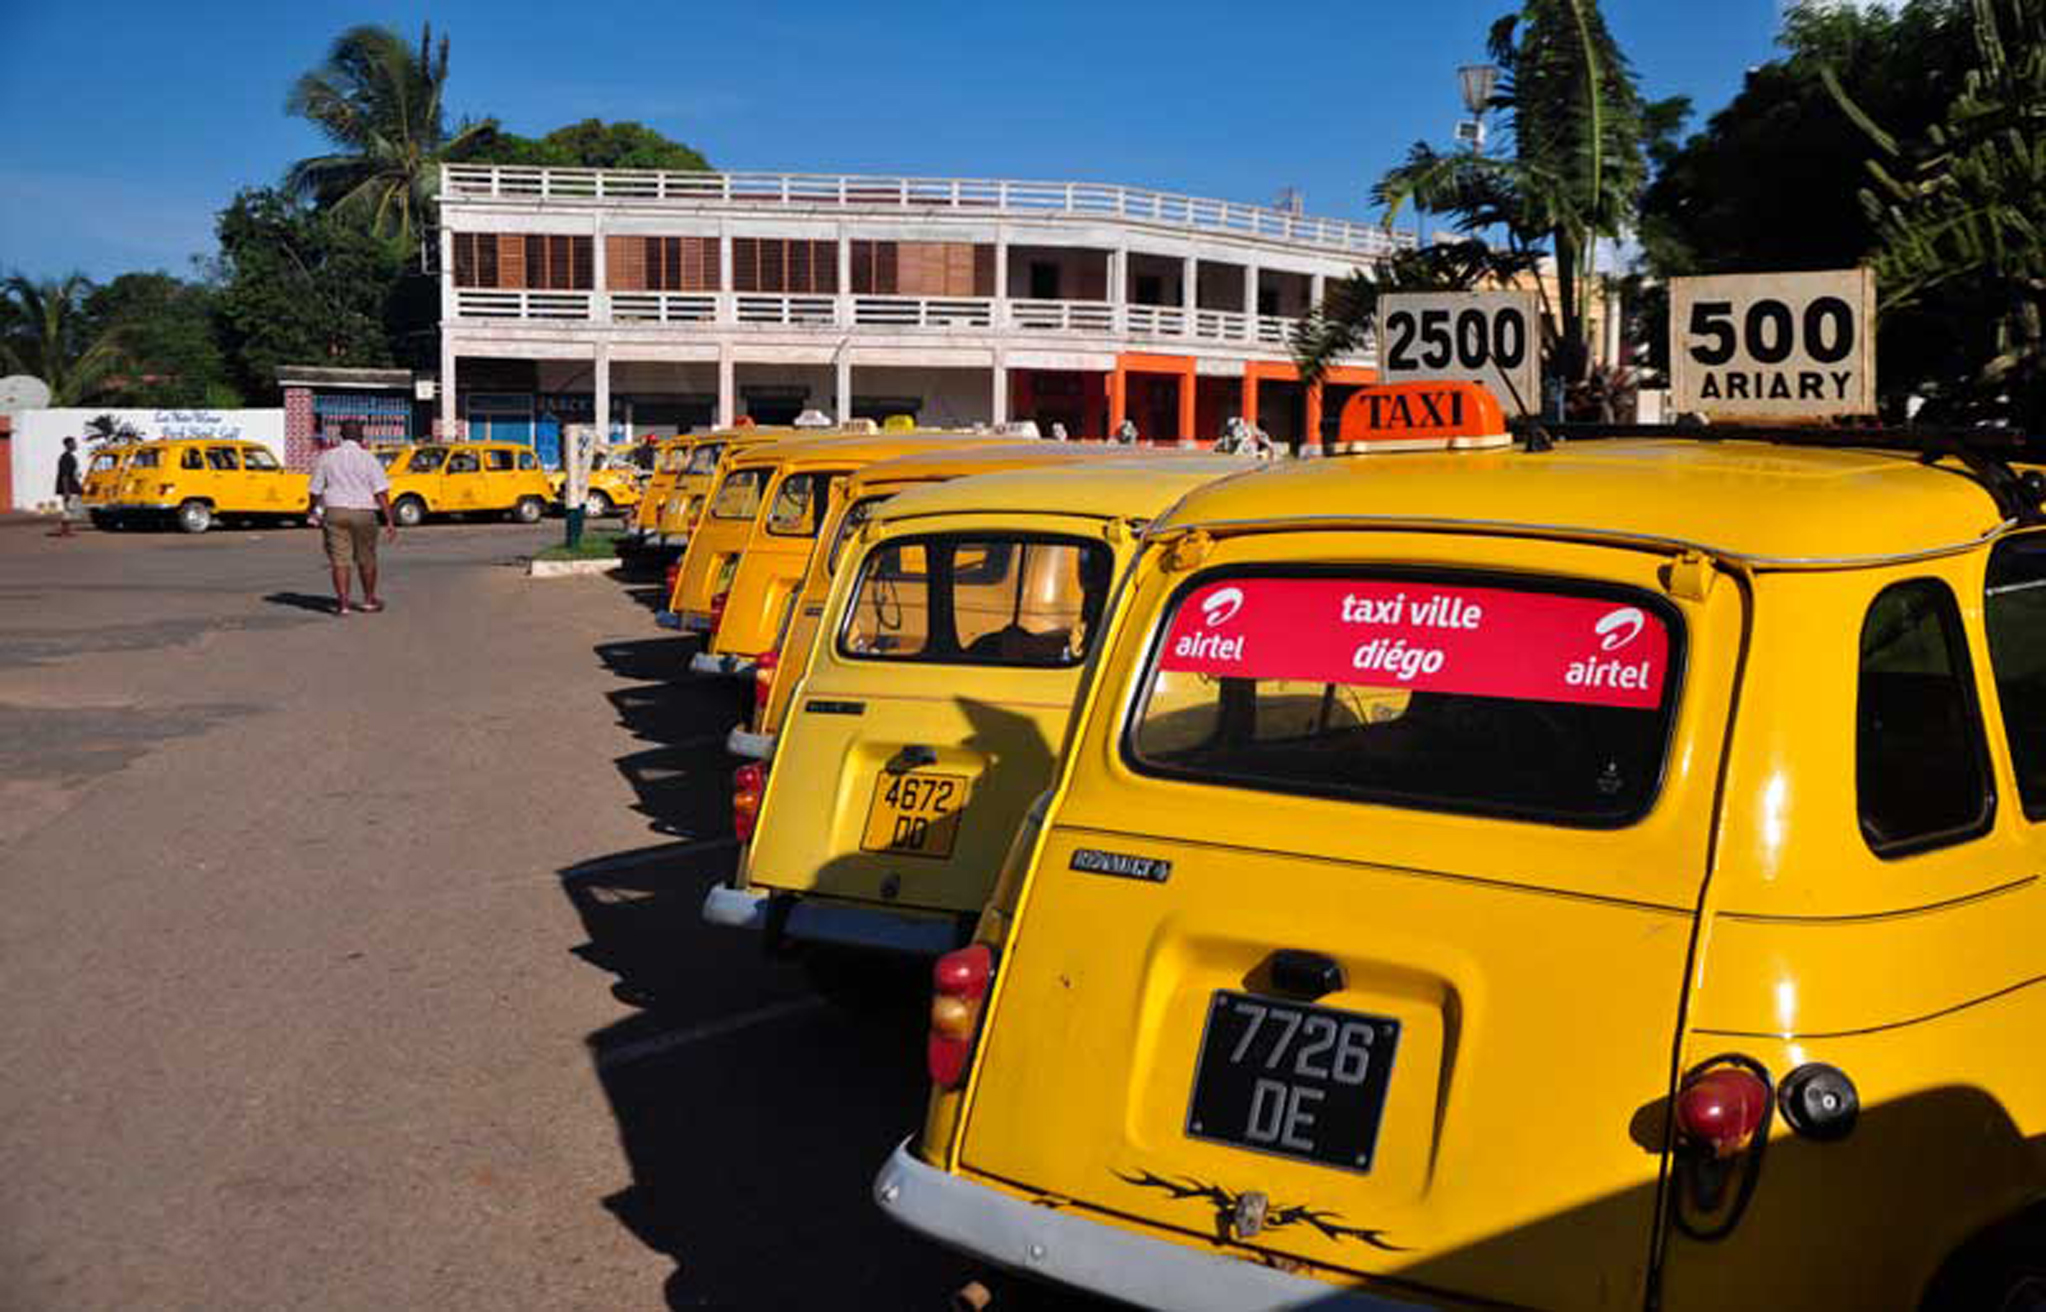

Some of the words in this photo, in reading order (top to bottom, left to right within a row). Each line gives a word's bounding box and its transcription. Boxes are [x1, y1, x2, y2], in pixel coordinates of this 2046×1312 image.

[1386, 307, 1526, 371] 2500
[1689, 296, 1855, 364] 500
[1700, 371, 1853, 400] ARIARY
[1360, 391, 1464, 430] TAXI
[1341, 593, 1406, 625] taxi
[1410, 597, 1482, 629] ville
[1175, 632, 1245, 661] airtel
[1353, 639, 1445, 681] diégo
[1565, 657, 1650, 690] airtel
[884, 778, 955, 812] 4672
[1230, 1004, 1374, 1085] 7726
[1246, 1079, 1326, 1151] DE
